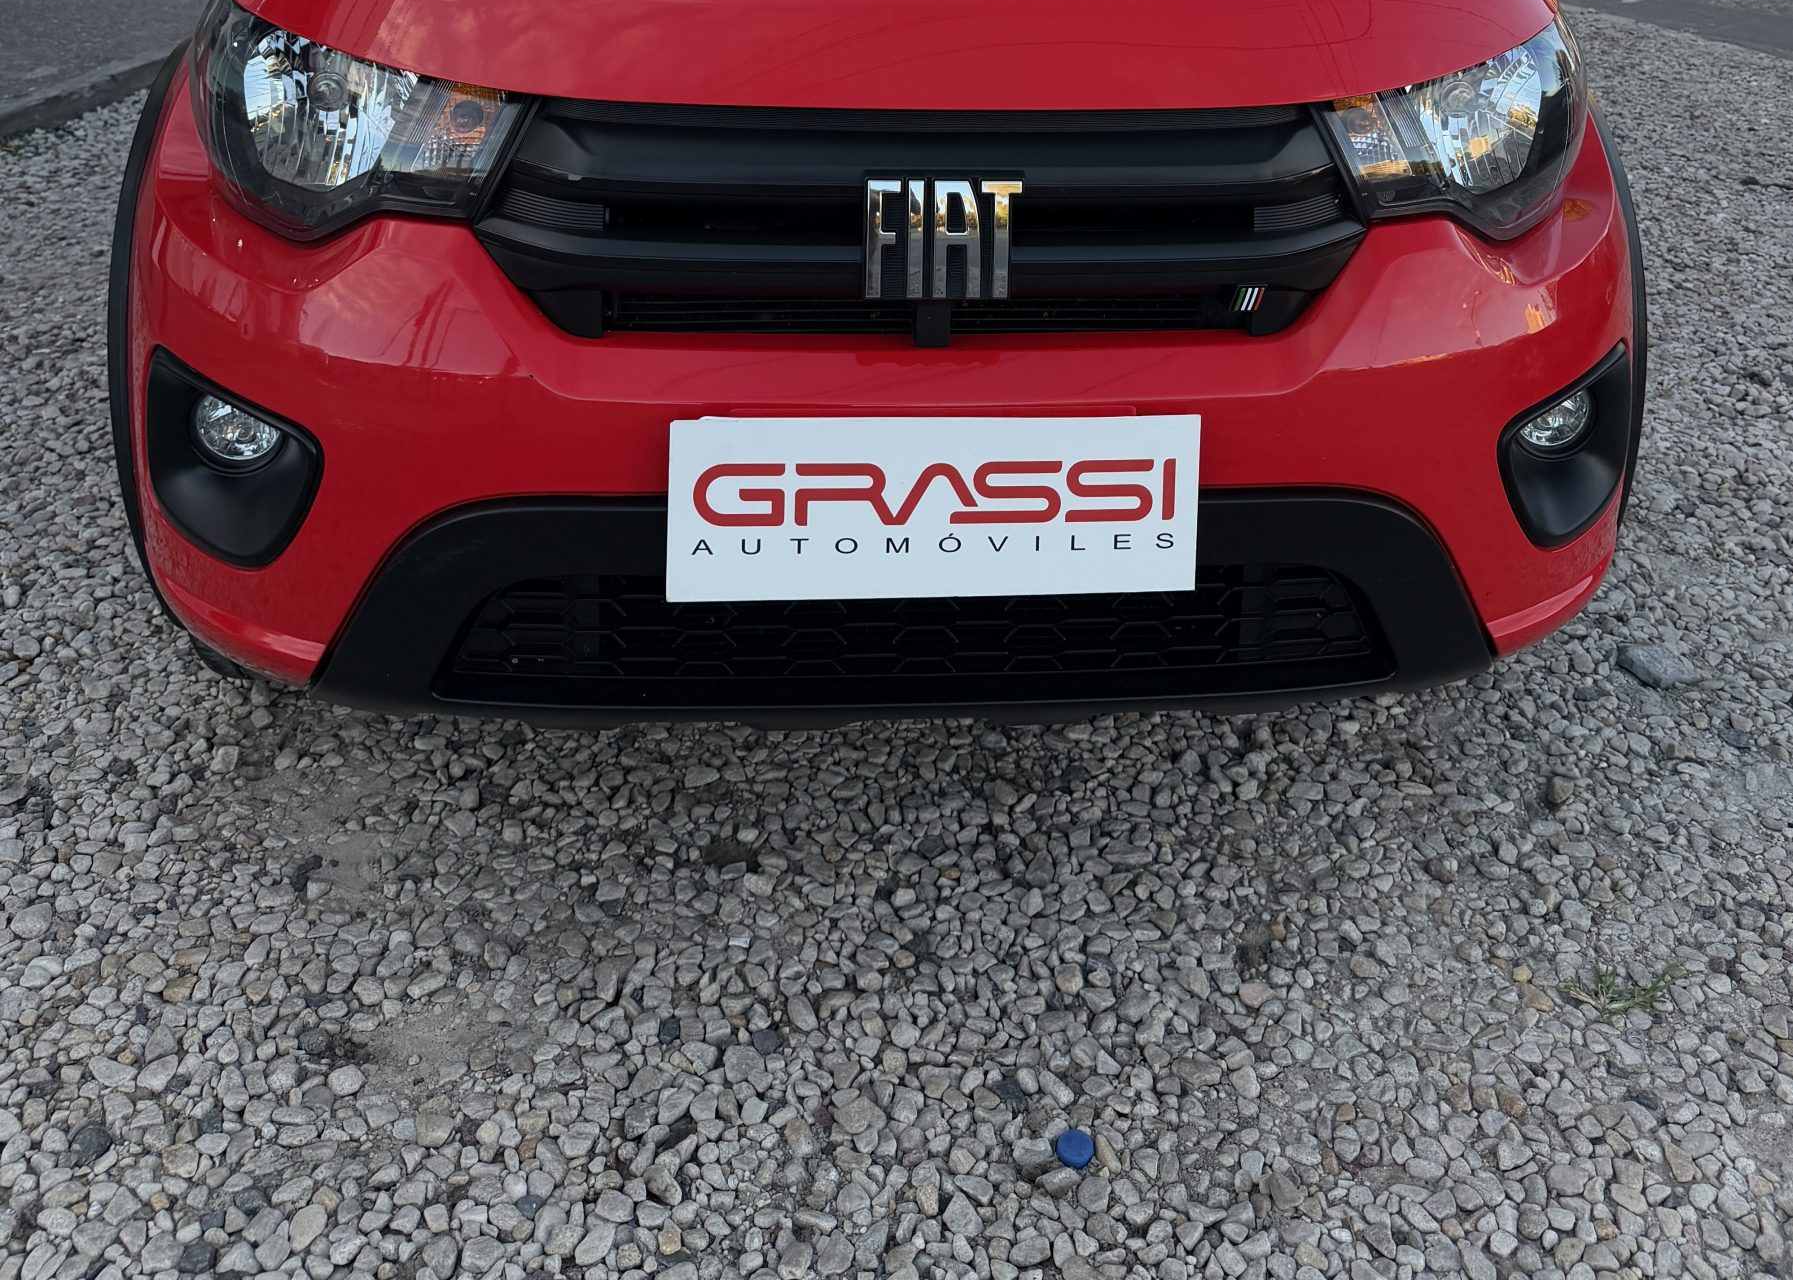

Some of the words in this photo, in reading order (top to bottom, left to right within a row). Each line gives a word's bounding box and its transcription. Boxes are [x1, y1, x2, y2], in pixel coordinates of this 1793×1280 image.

[865, 179, 1023, 298] FIAT
[693, 458, 1176, 527] GRASSI
[691, 532, 1175, 556] AUTOMÓVILES
